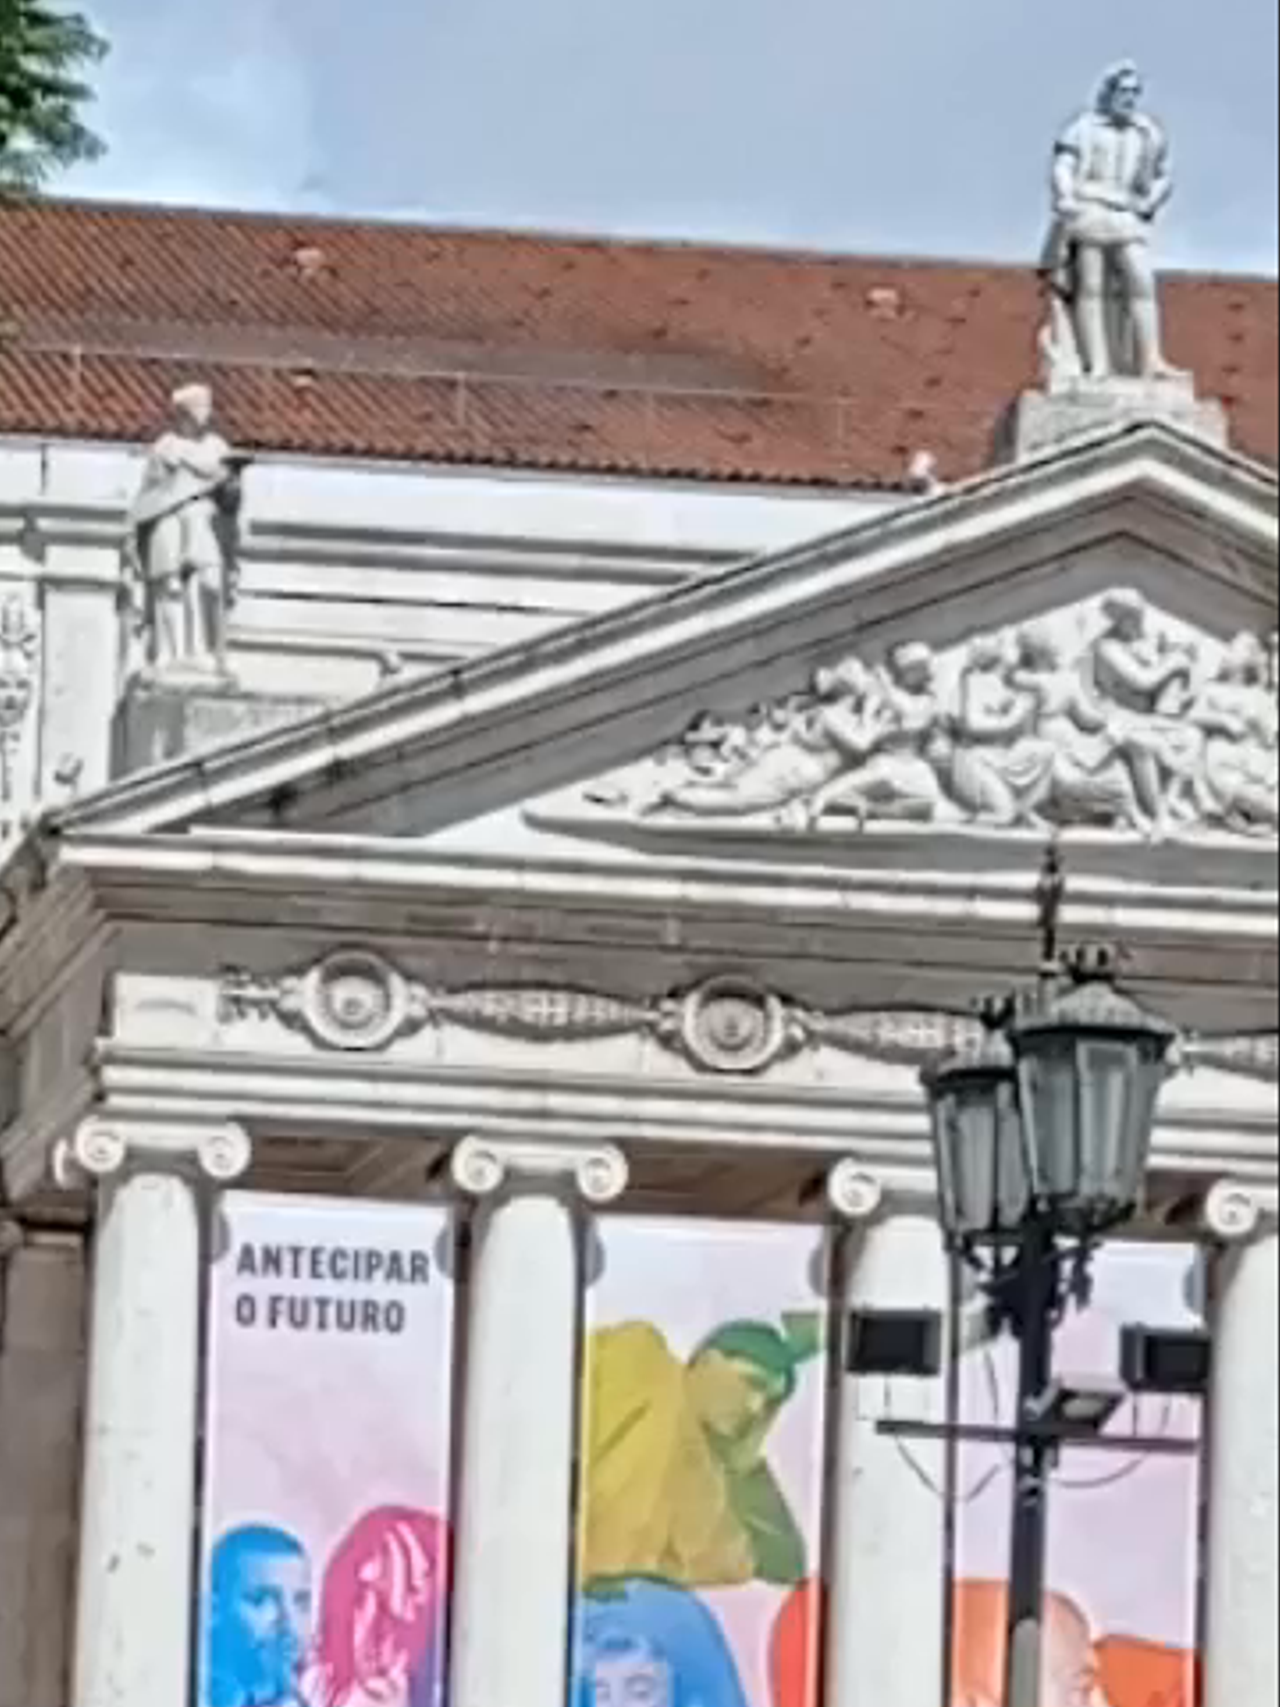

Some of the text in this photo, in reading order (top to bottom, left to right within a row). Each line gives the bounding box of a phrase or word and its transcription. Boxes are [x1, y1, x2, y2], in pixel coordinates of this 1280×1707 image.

[237, 1243, 430, 1284] ANTECIPAR
[236, 1293, 405, 1333] O FUTURO
